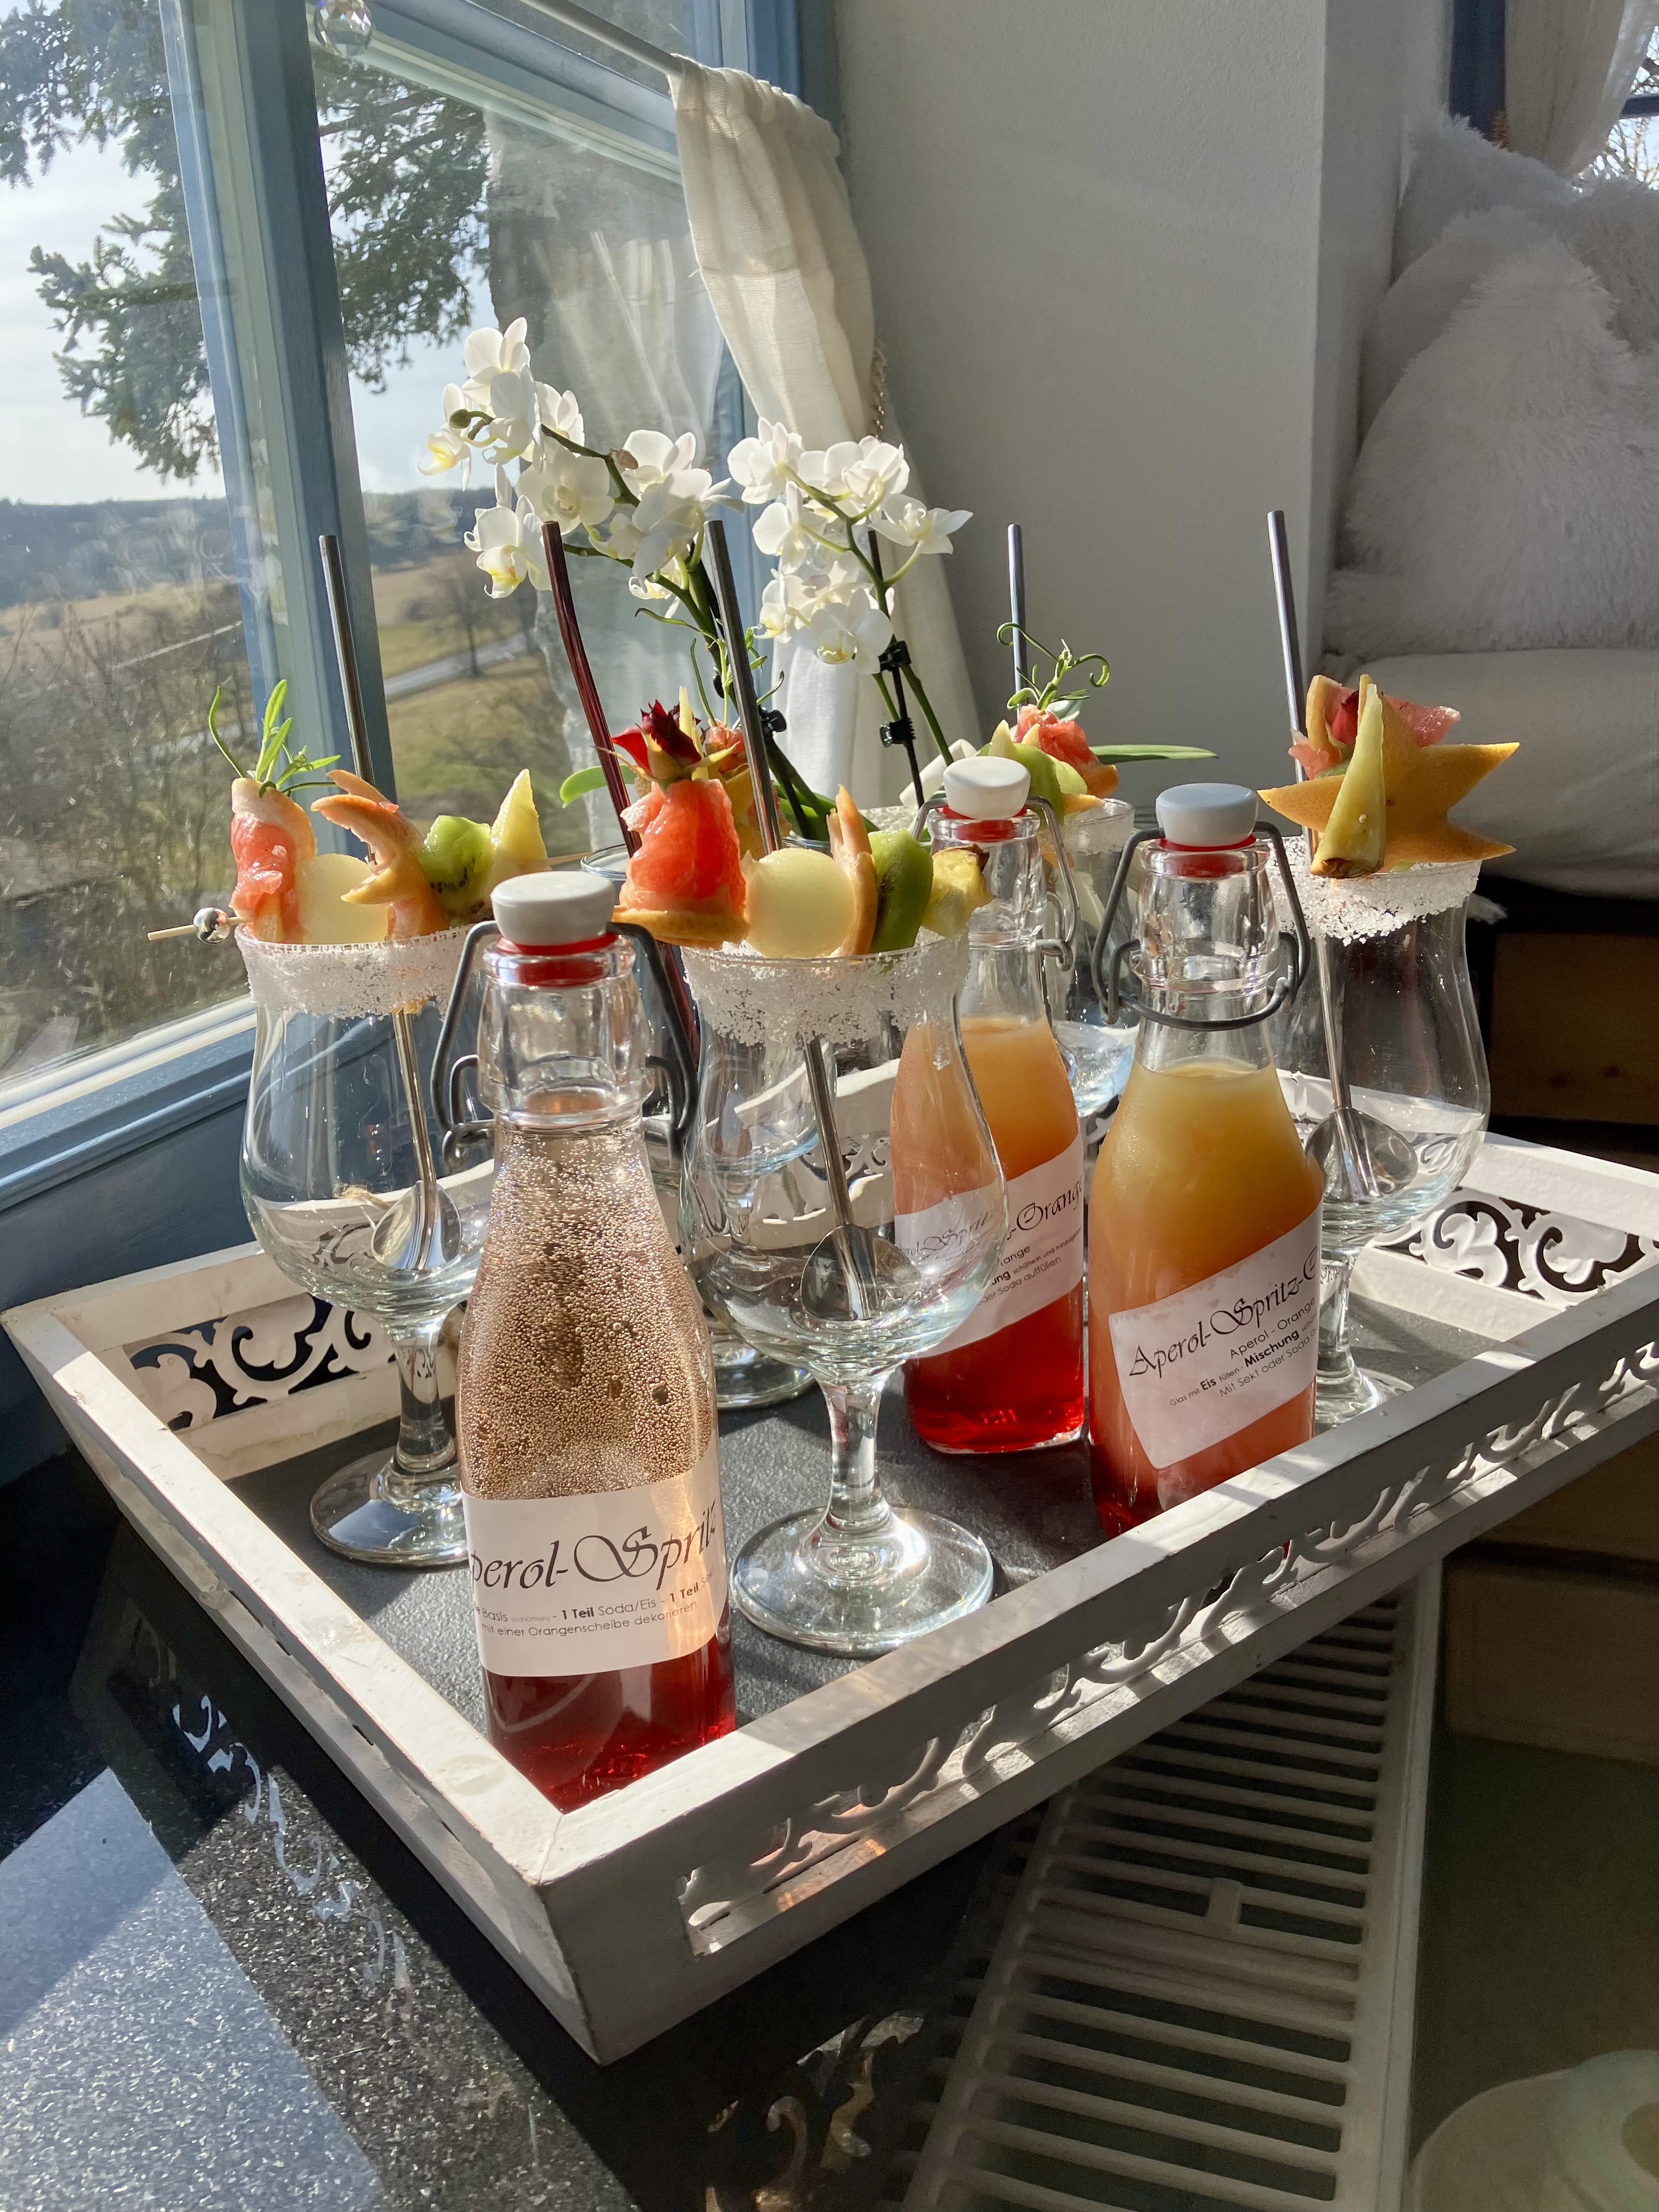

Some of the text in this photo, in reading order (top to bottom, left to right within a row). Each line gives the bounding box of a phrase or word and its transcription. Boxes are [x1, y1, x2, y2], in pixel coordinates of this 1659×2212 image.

[998, 1279, 1022, 1295] Soda
[1024, 1256, 1062, 1281] auffüllen
[1001, 1245, 1030, 1267] range
[1013, 1255, 1041, 1274] schütteln
[1042, 1247, 1055, 1258] und
[1231, 1329, 1269, 1359] Aperol
[1277, 1297, 1316, 1330] Orange
[1169, 1395, 1187, 1406] Glas
[1188, 1388, 1200, 1398] mit
[1200, 1378, 1216, 1391] Eis
[1244, 1330, 1300, 1368] Mischung
[1219, 1335, 1310, 1397] Mit Sekt oder Soda
[471, 1499, 716, 1594] perol-Spritz
[482, 1607, 508, 1622] Basis
[561, 1610, 567, 1620] 1
[572, 1607, 595, 1619] Teil
[598, 1599, 656, 1616] Soda/Eis
[669, 1593, 675, 1602] 1
[680, 1582, 698, 1599] Teil
[497, 1626, 524, 1637] einer
[528, 1619, 630, 1637] Orangenscheibe
[634, 1600, 697, 1625] dekorieren
